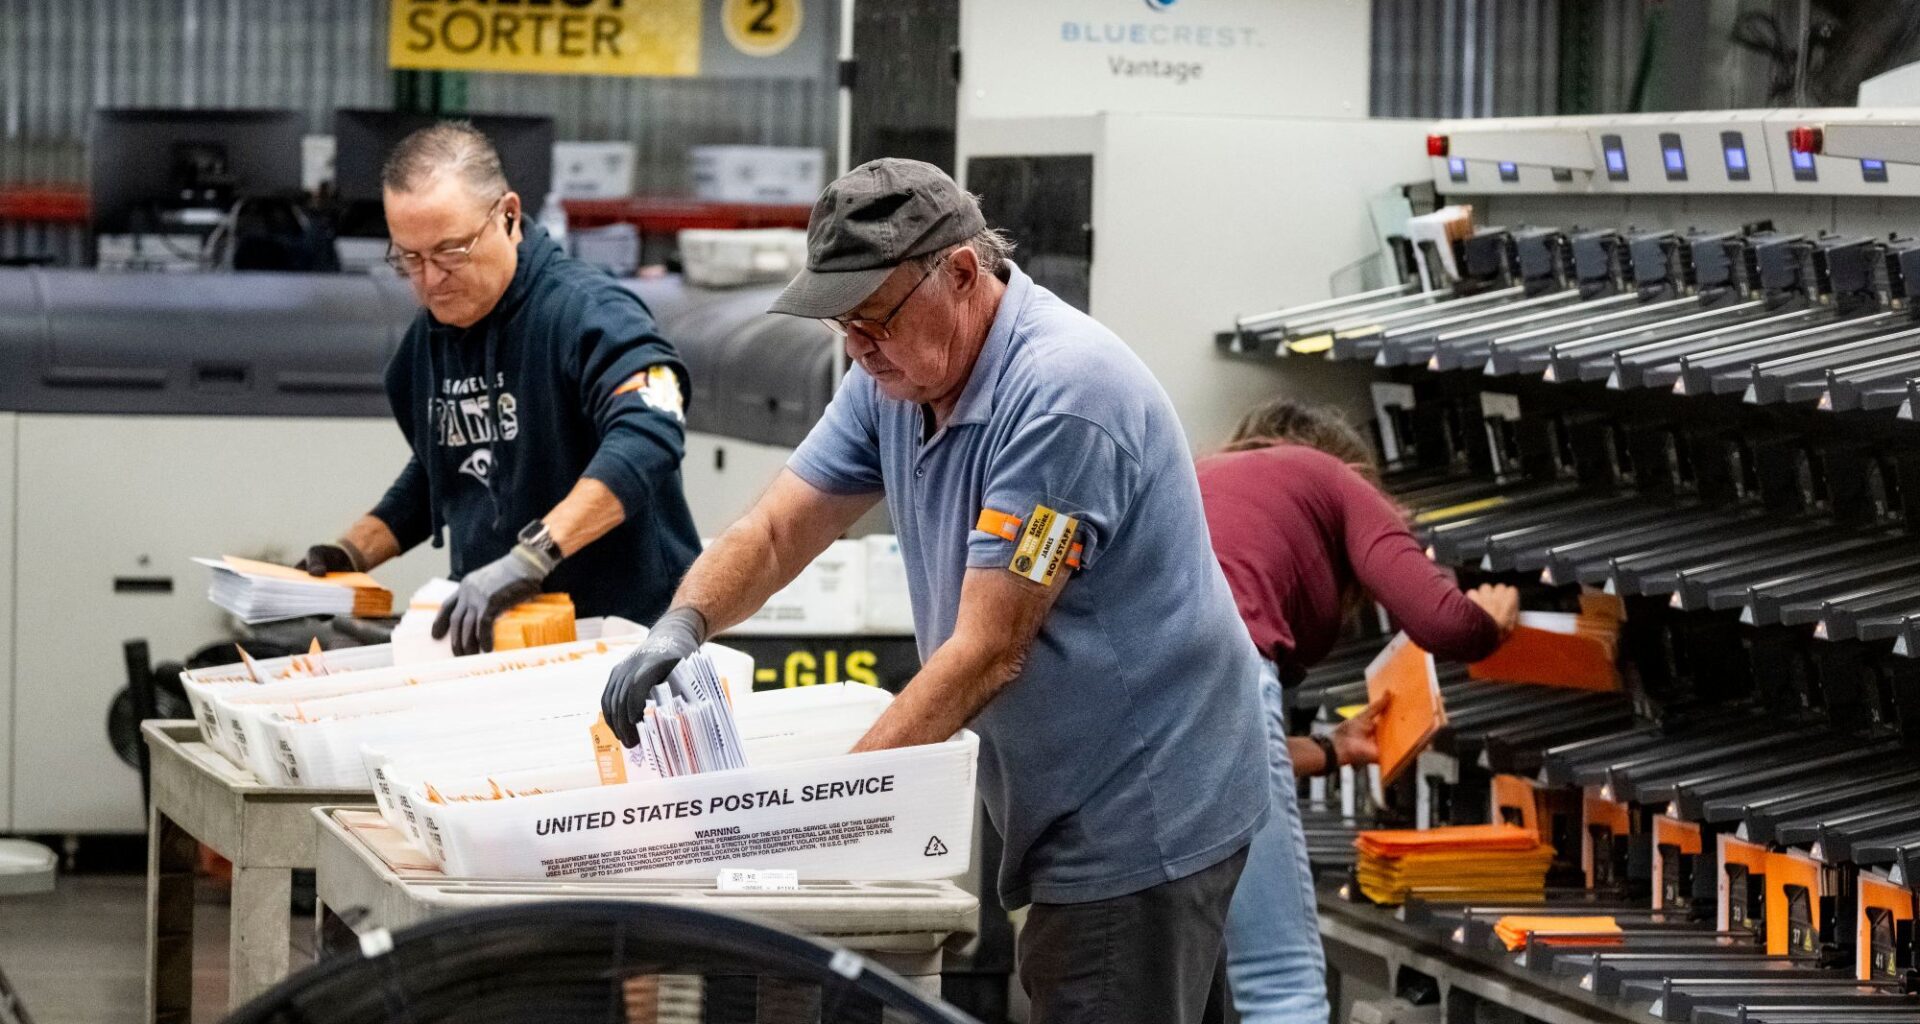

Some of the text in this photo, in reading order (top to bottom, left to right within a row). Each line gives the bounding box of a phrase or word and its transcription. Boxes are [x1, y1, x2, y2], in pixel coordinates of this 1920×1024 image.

[406, 9, 625, 58] SORTER
[747, 0, 775, 34] 2
[1107, 56, 1203, 85] Vantage
[1042, 538, 1054, 558] JAMES
[1046, 528, 1071, 577] ROV STAFF
[536, 775, 895, 836] UNITED STATES POSTAL SERVICE
[555, 855, 586, 863] EQUIPMENT
[648, 843, 676, 851] RECYCLED
[716, 834, 749, 843] PERMISSION
[863, 815, 894, 824] EQUIPMENT
[574, 859, 599, 867] PURPOSE
[648, 849, 680, 857] TRANSPORT
[721, 840, 746, 848] STRICTLY
[748, 836, 781, 844] PROHIBITED
[791, 831, 816, 839] FEDERAL
[695, 826, 741, 839] WARNING
[562, 865, 596, 875] ELECTRONIC
[598, 861, 626, 870] TRACKING
[627, 857, 664, 866] TECHNOLOGY
[674, 852, 698, 860] MONITOR
[712, 847, 739, 855] LOCATION
[796, 836, 826, 844] VIOLATORS
[841, 831, 865, 839] SUBJECT
[1793, 928, 1801, 945] 37
[1875, 952, 1884, 969] 41
